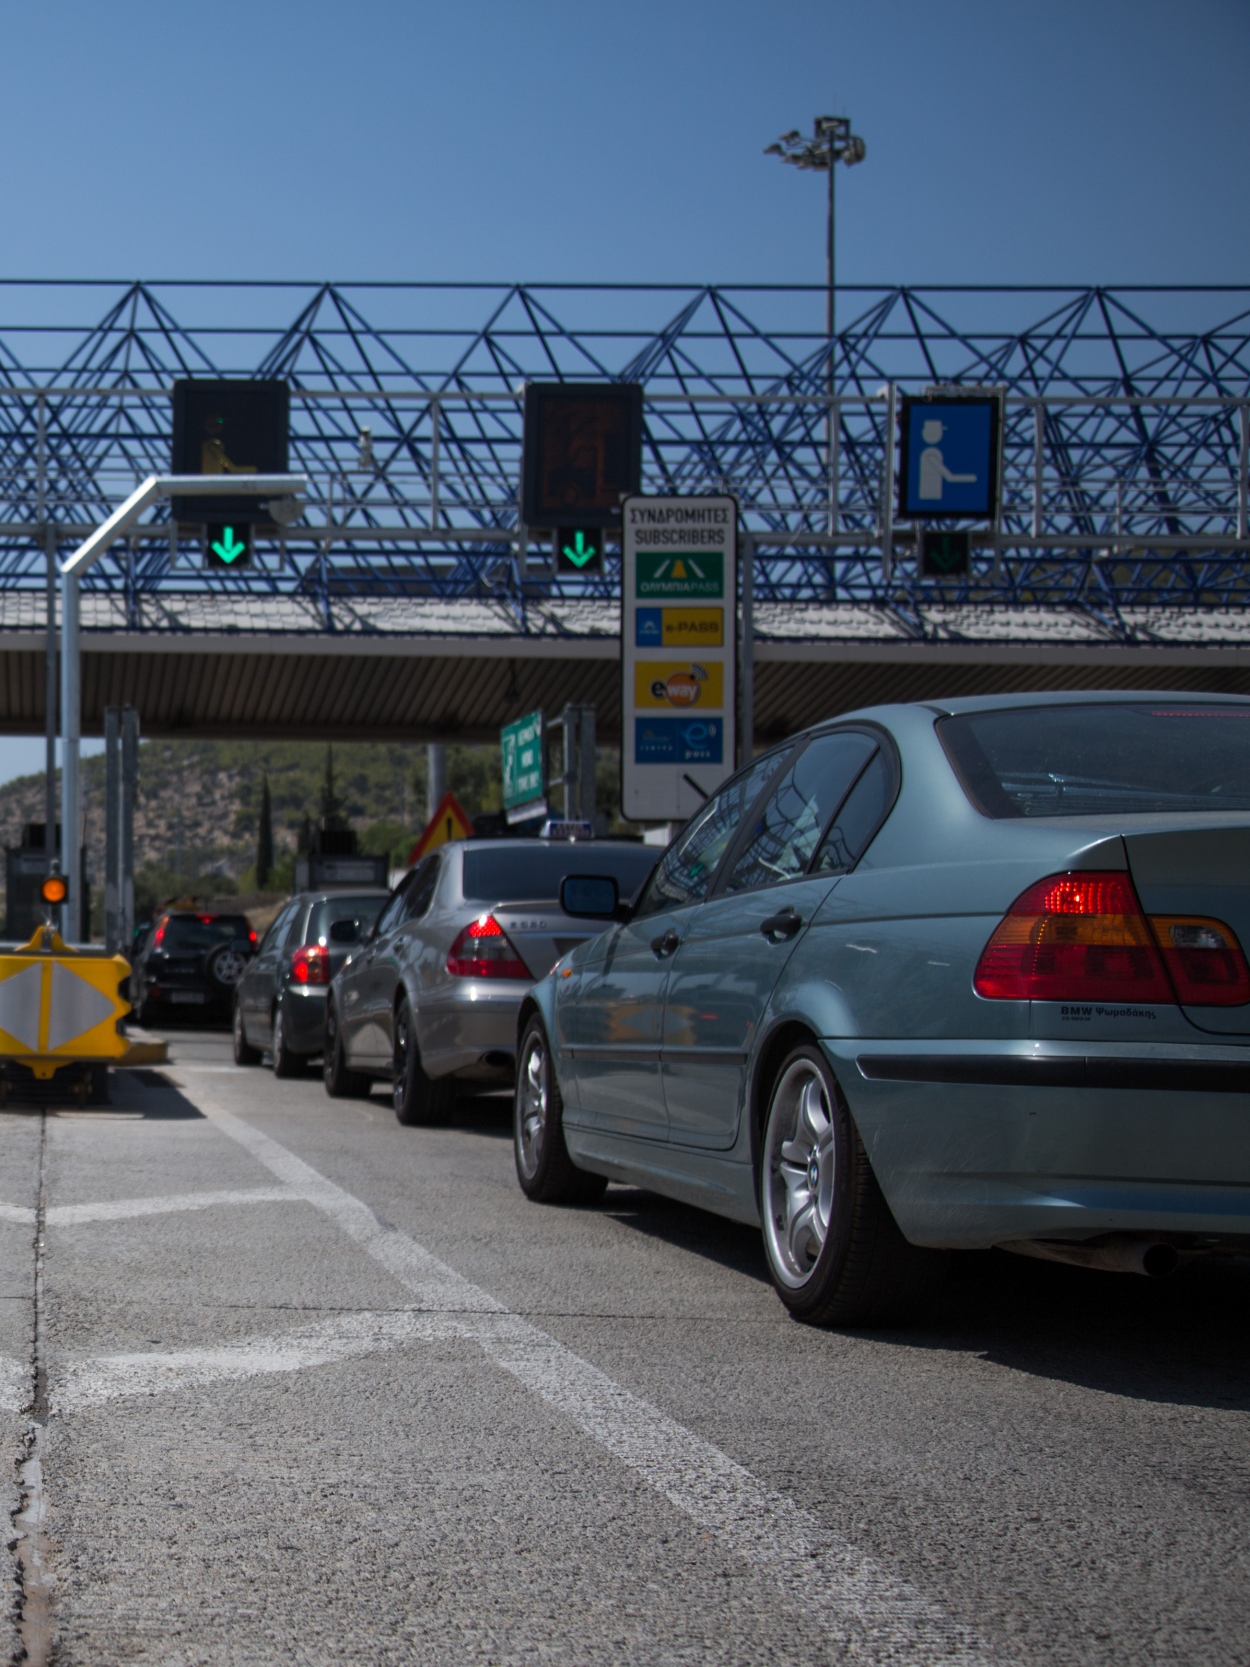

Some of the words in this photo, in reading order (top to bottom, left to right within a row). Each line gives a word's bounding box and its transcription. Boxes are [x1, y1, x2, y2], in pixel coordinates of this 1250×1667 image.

[630, 508, 729, 524] ΣΥΝΔΡΟΜΗΤΕΣ
[635, 528, 725, 545] SUBSCRIBERS
[1060, 1006, 1093, 1015] BMW
[1095, 1006, 1156, 1020] Ψωμαδάκης
